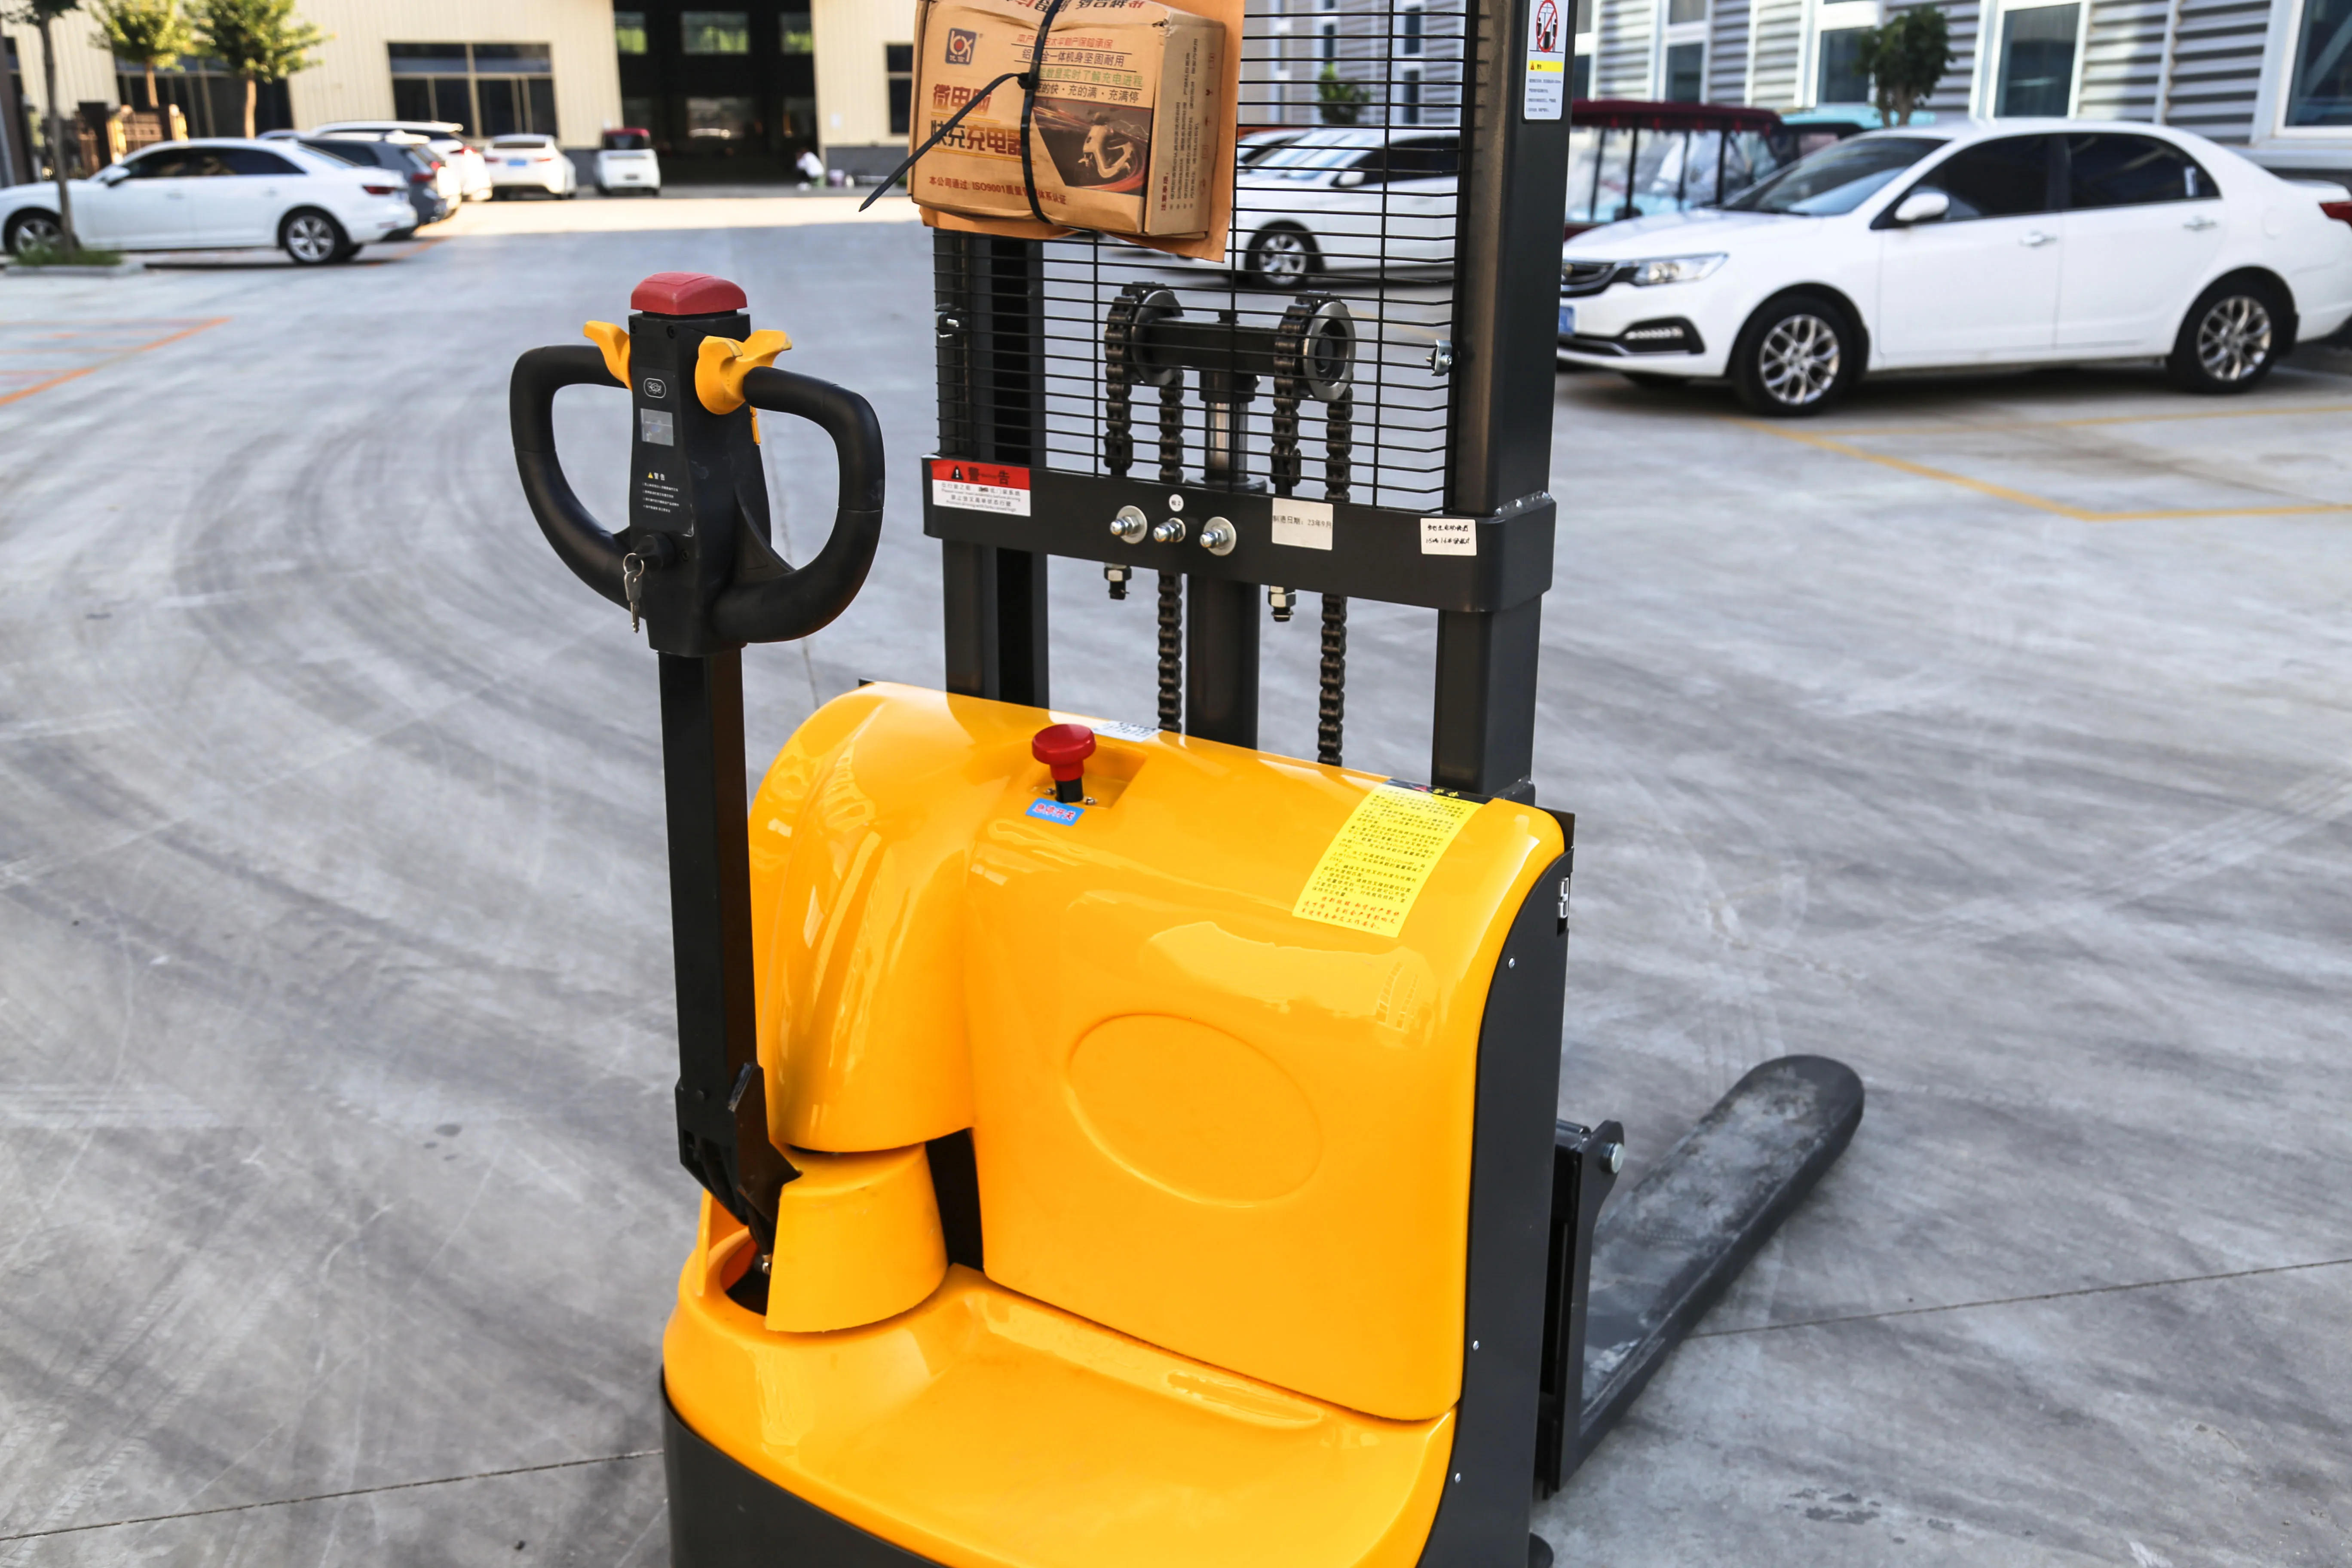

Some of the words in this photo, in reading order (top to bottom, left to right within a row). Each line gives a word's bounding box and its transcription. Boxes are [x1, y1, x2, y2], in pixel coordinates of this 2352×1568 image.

[1022, 48, 1124, 67] 铝金一体机身坚固耐用
